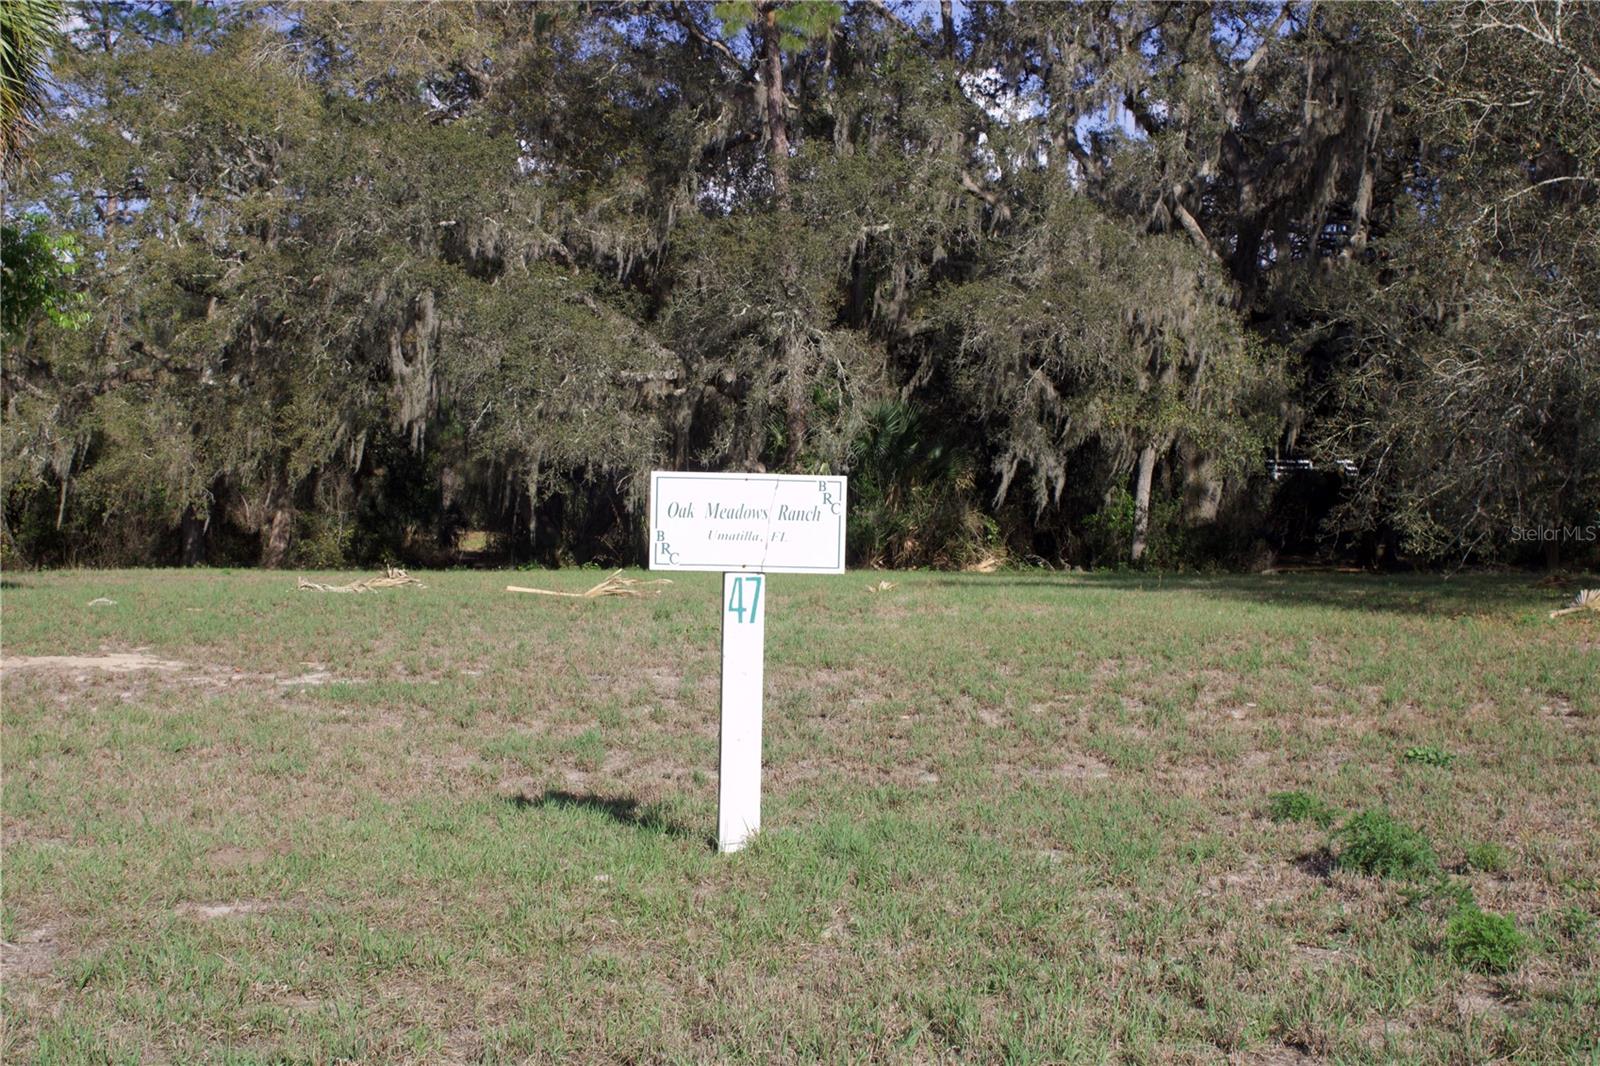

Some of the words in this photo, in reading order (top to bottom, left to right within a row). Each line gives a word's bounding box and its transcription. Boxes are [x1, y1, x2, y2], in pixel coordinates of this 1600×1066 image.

[667, 501, 695, 519] Oak
[705, 502, 769, 522] Meadows
[778, 504, 822, 522] Ranch
[728, 576, 762, 624] 47
